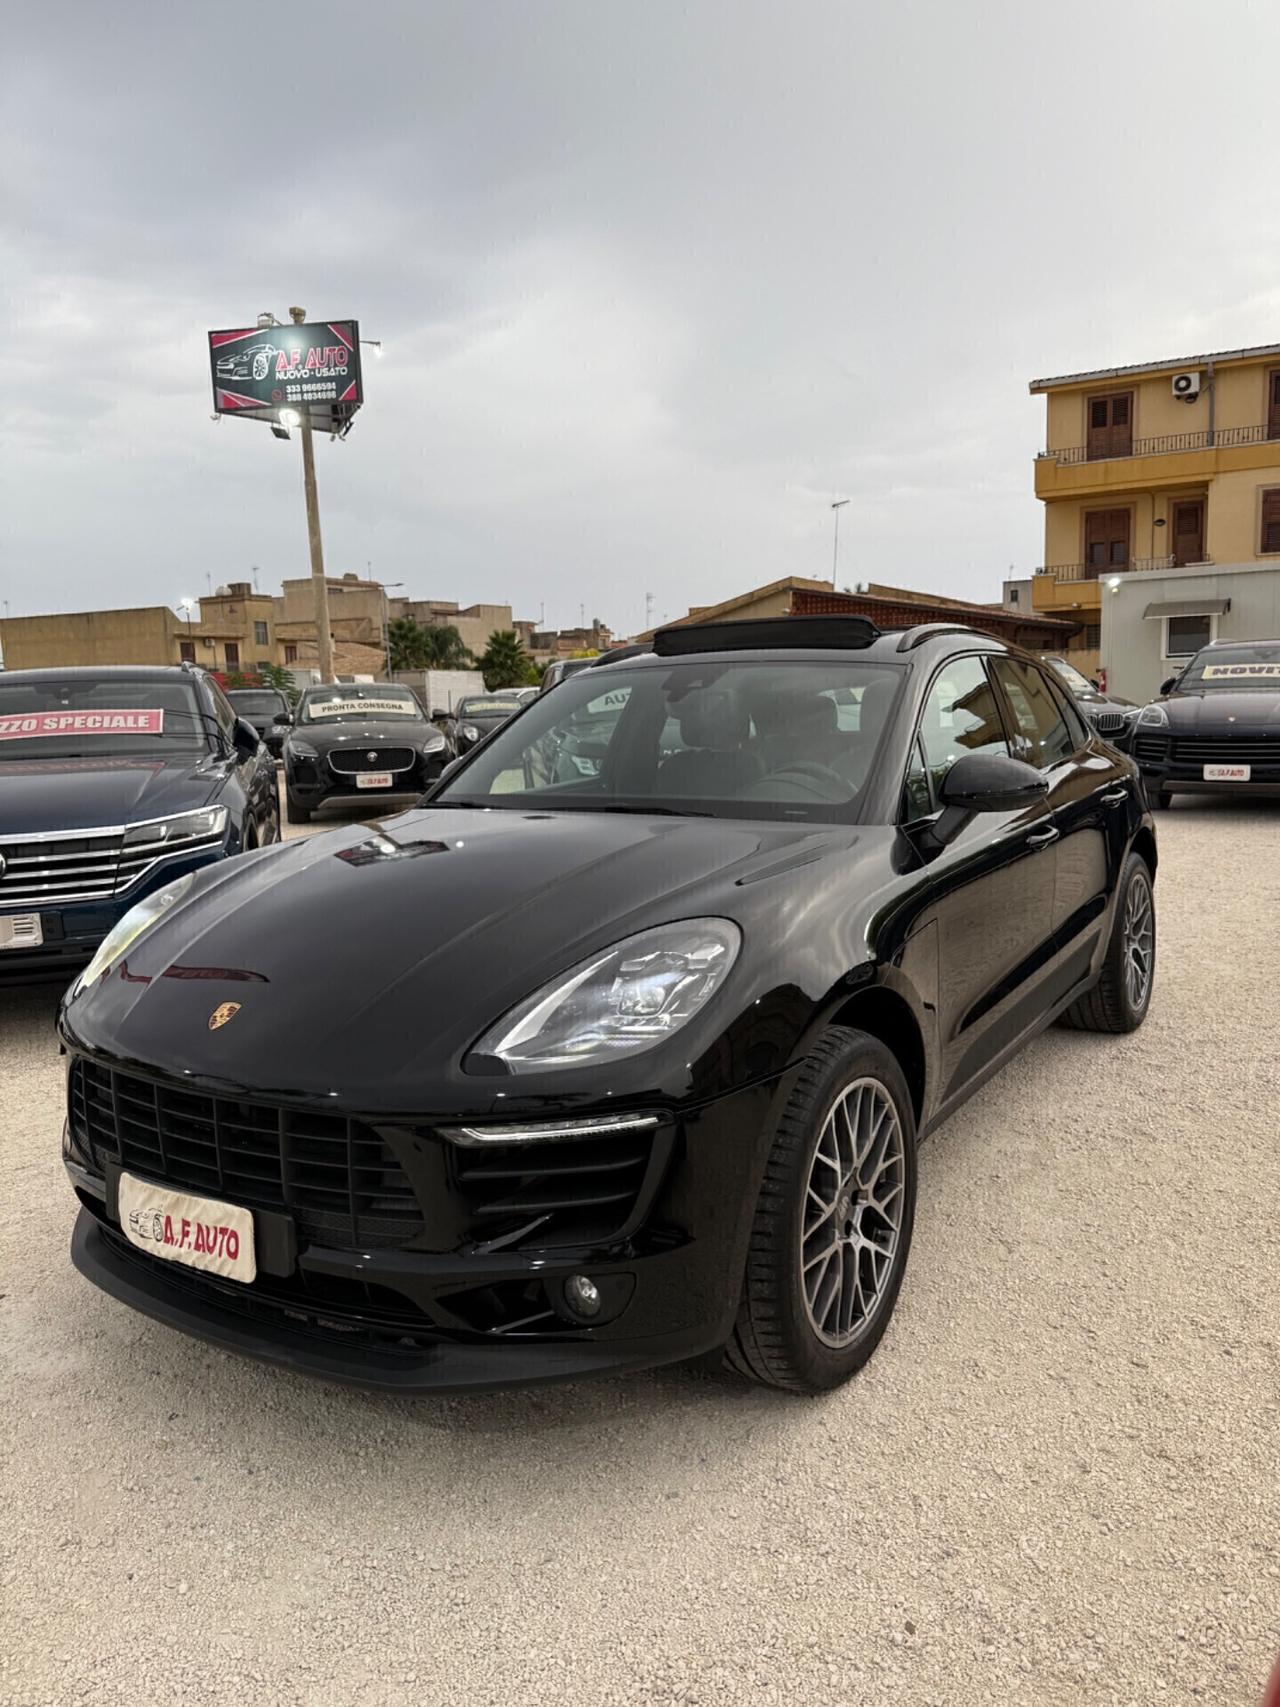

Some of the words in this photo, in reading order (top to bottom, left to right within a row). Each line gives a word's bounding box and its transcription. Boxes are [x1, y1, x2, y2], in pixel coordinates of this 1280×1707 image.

[305, 346, 348, 369] AUTO
[276, 369, 309, 380] NUOVO
[315, 367, 348, 377] USATO
[605, 693, 631, 705] AU
[321, 702, 356, 713] PRONTA
[357, 701, 404, 710] CONSEGNA
[43, 715, 150, 730] SPECIALE
